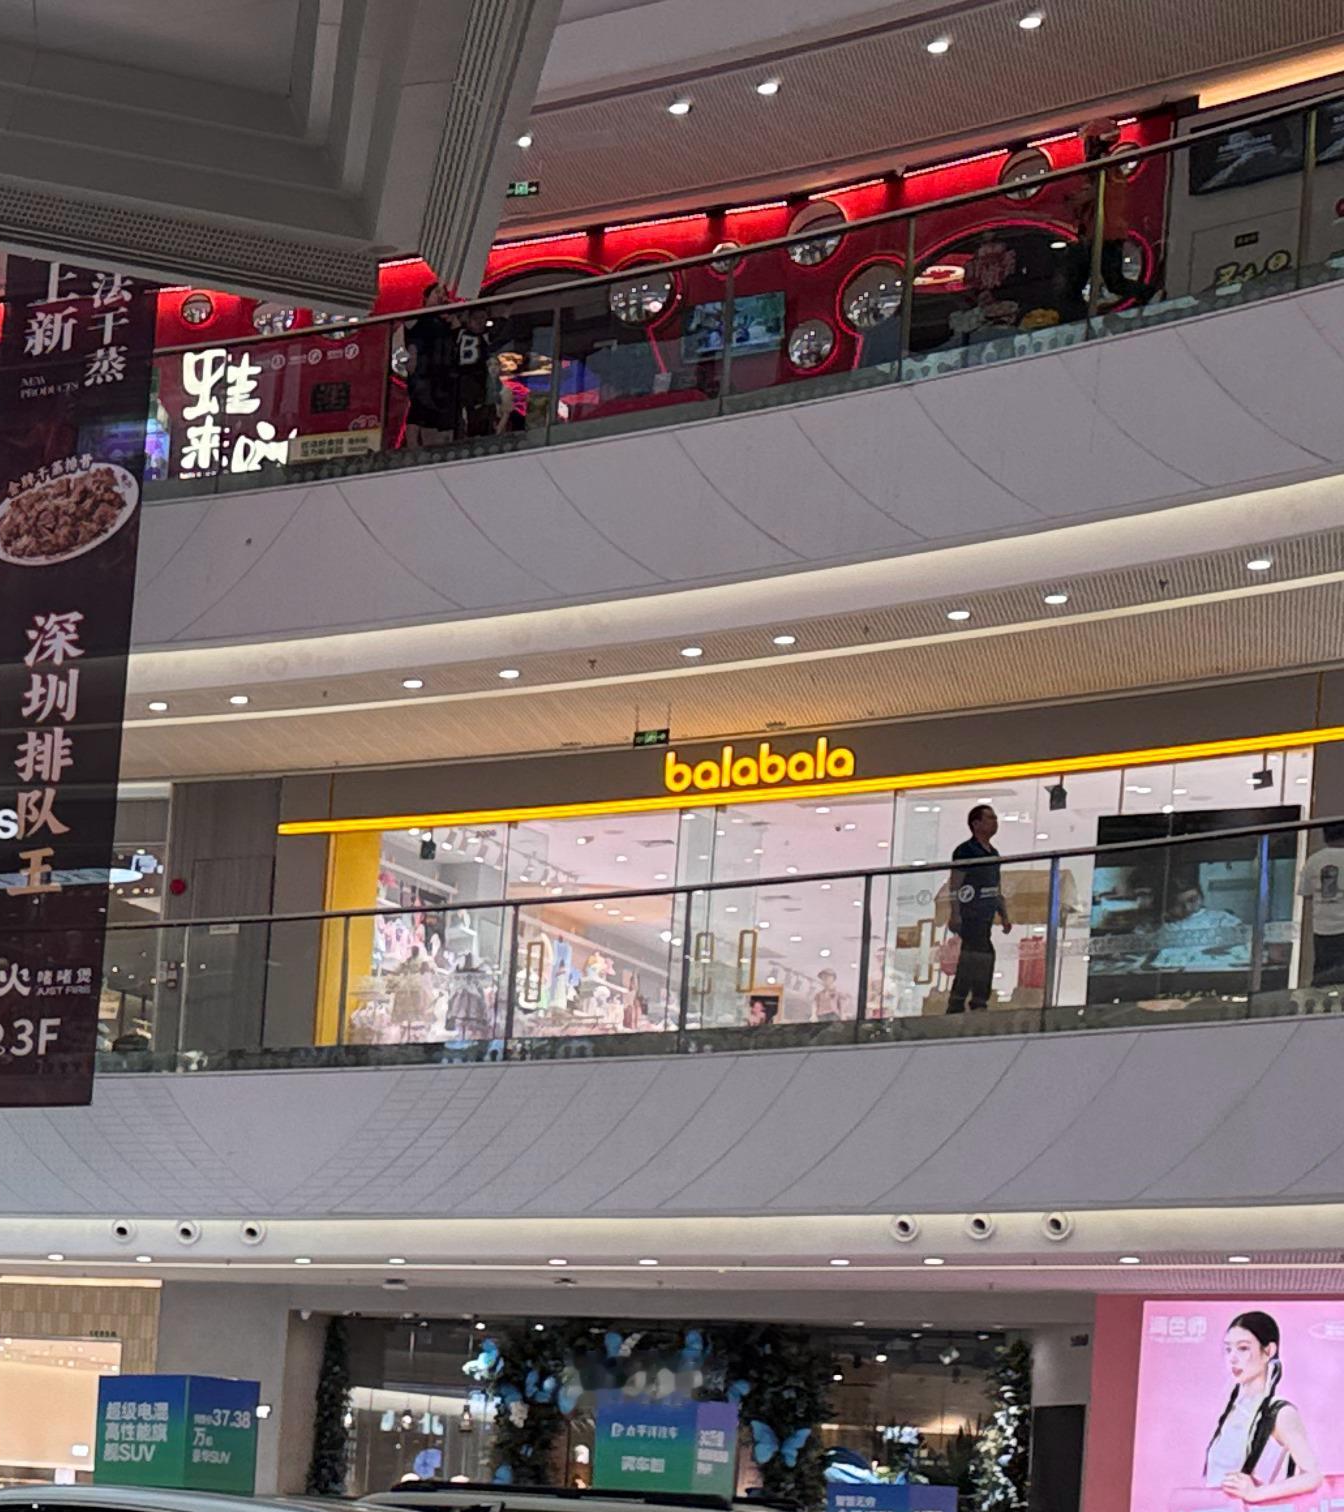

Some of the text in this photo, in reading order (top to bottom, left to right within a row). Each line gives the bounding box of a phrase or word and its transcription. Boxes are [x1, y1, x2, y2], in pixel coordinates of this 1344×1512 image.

[23, 262, 80, 356] 上新
[6, 610, 86, 898] 深圳排队王
[664, 736, 856, 793] balabala
[9, 1017, 62, 1057] 3F
